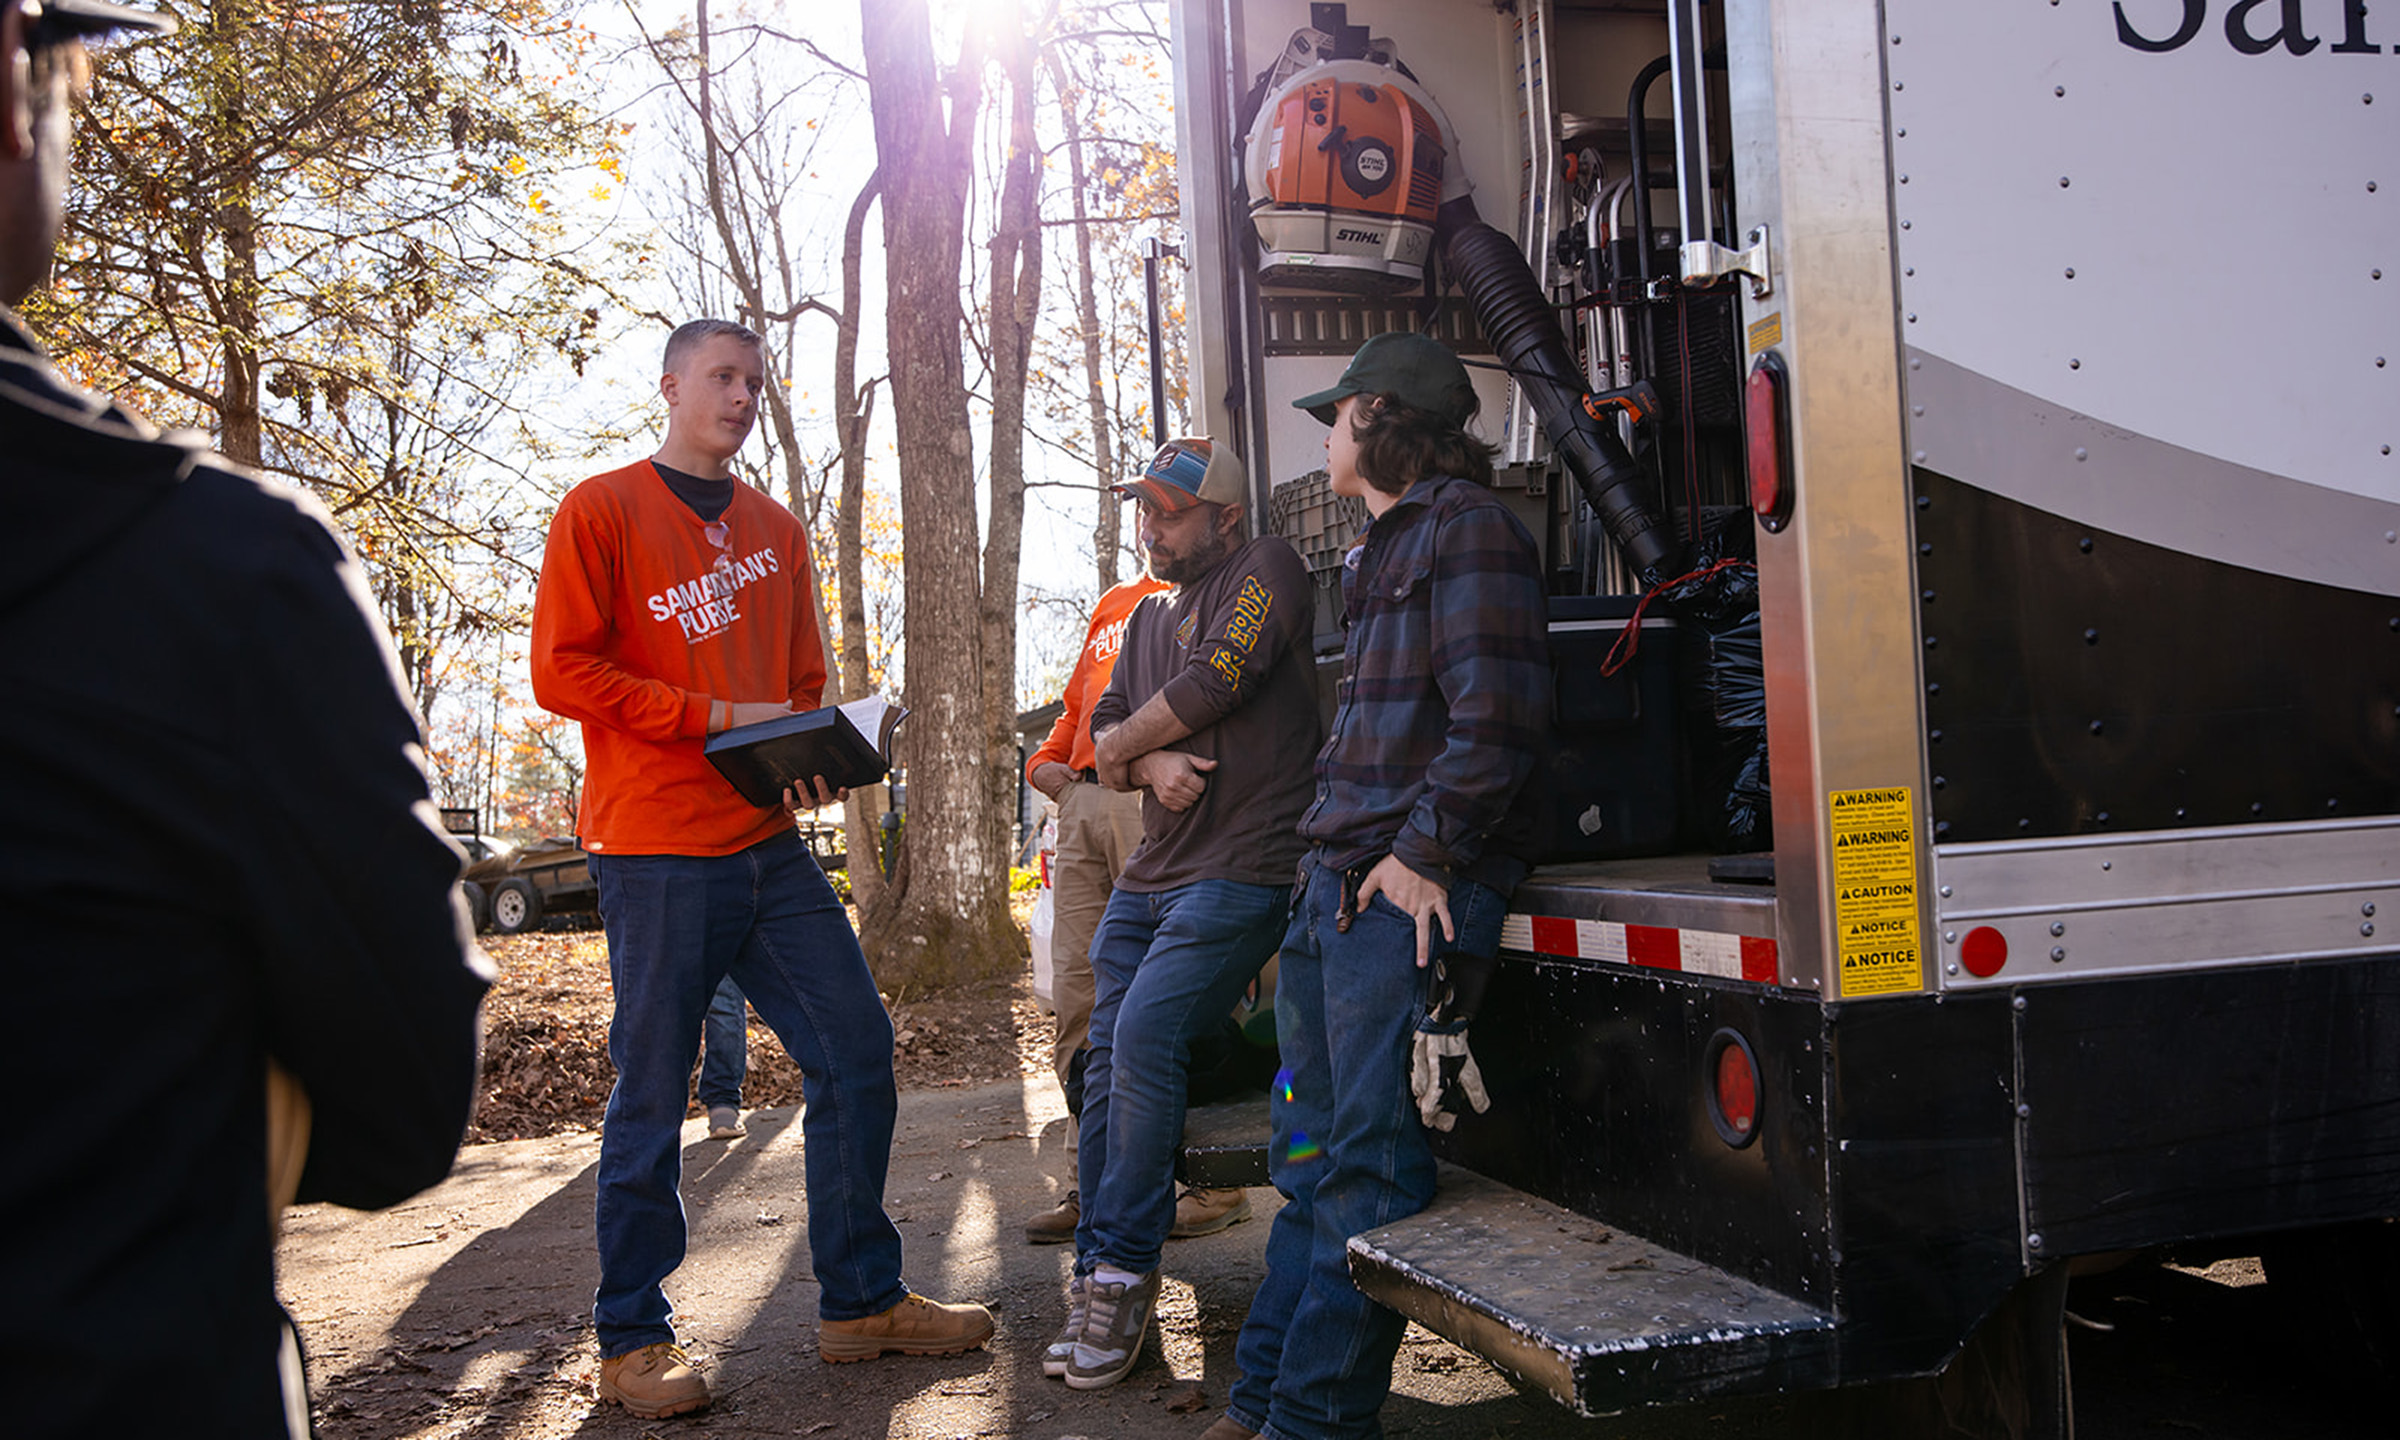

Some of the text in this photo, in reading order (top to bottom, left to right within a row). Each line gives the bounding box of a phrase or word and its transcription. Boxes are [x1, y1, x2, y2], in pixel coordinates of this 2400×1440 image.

[2112, 0, 2400, 56] Sa
[1336, 229, 1381, 244] STIHL
[677, 596, 741, 639] PURSE
[1846, 790, 1905, 805] WARNING
[1848, 829, 1909, 845] WARNING
[1852, 884, 1912, 898] CAUTION
[1861, 920, 1906, 933] NOTICE
[1859, 950, 1915, 966] NOTICE
